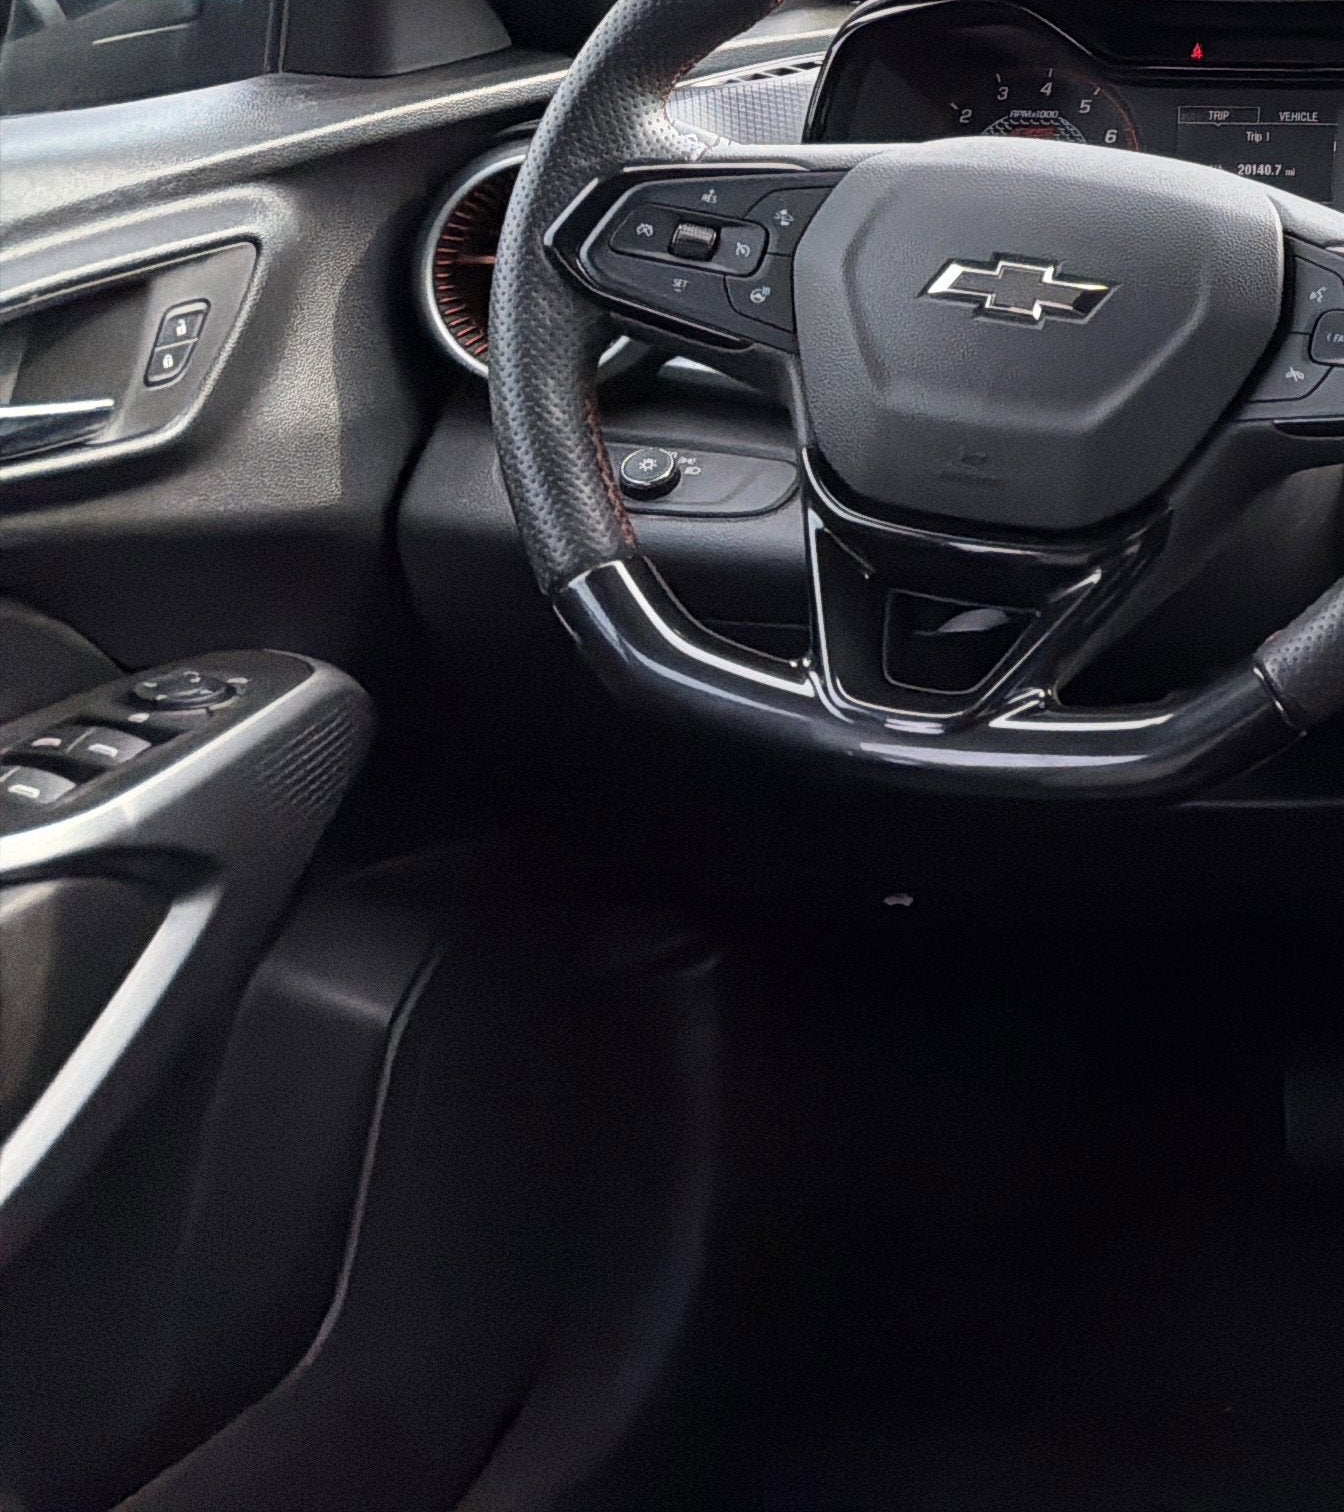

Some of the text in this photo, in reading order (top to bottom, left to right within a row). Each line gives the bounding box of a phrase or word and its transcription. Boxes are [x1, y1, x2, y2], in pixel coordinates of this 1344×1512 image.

[997, 87, 1009, 100] 3
[1040, 82, 1052, 96] 4
[1079, 99, 1092, 113] 5
[959, 109, 972, 123] 2
[1208, 110, 1230, 121] TRIP
[1279, 111, 1319, 122] VEHICLE
[1105, 129, 1118, 143] 6
[1246, 131, 1263, 144] Trip
[1237, 164, 1282, 176] 20140.7
[701, 194, 718, 204] RES
[672, 278, 688, 289] SET
